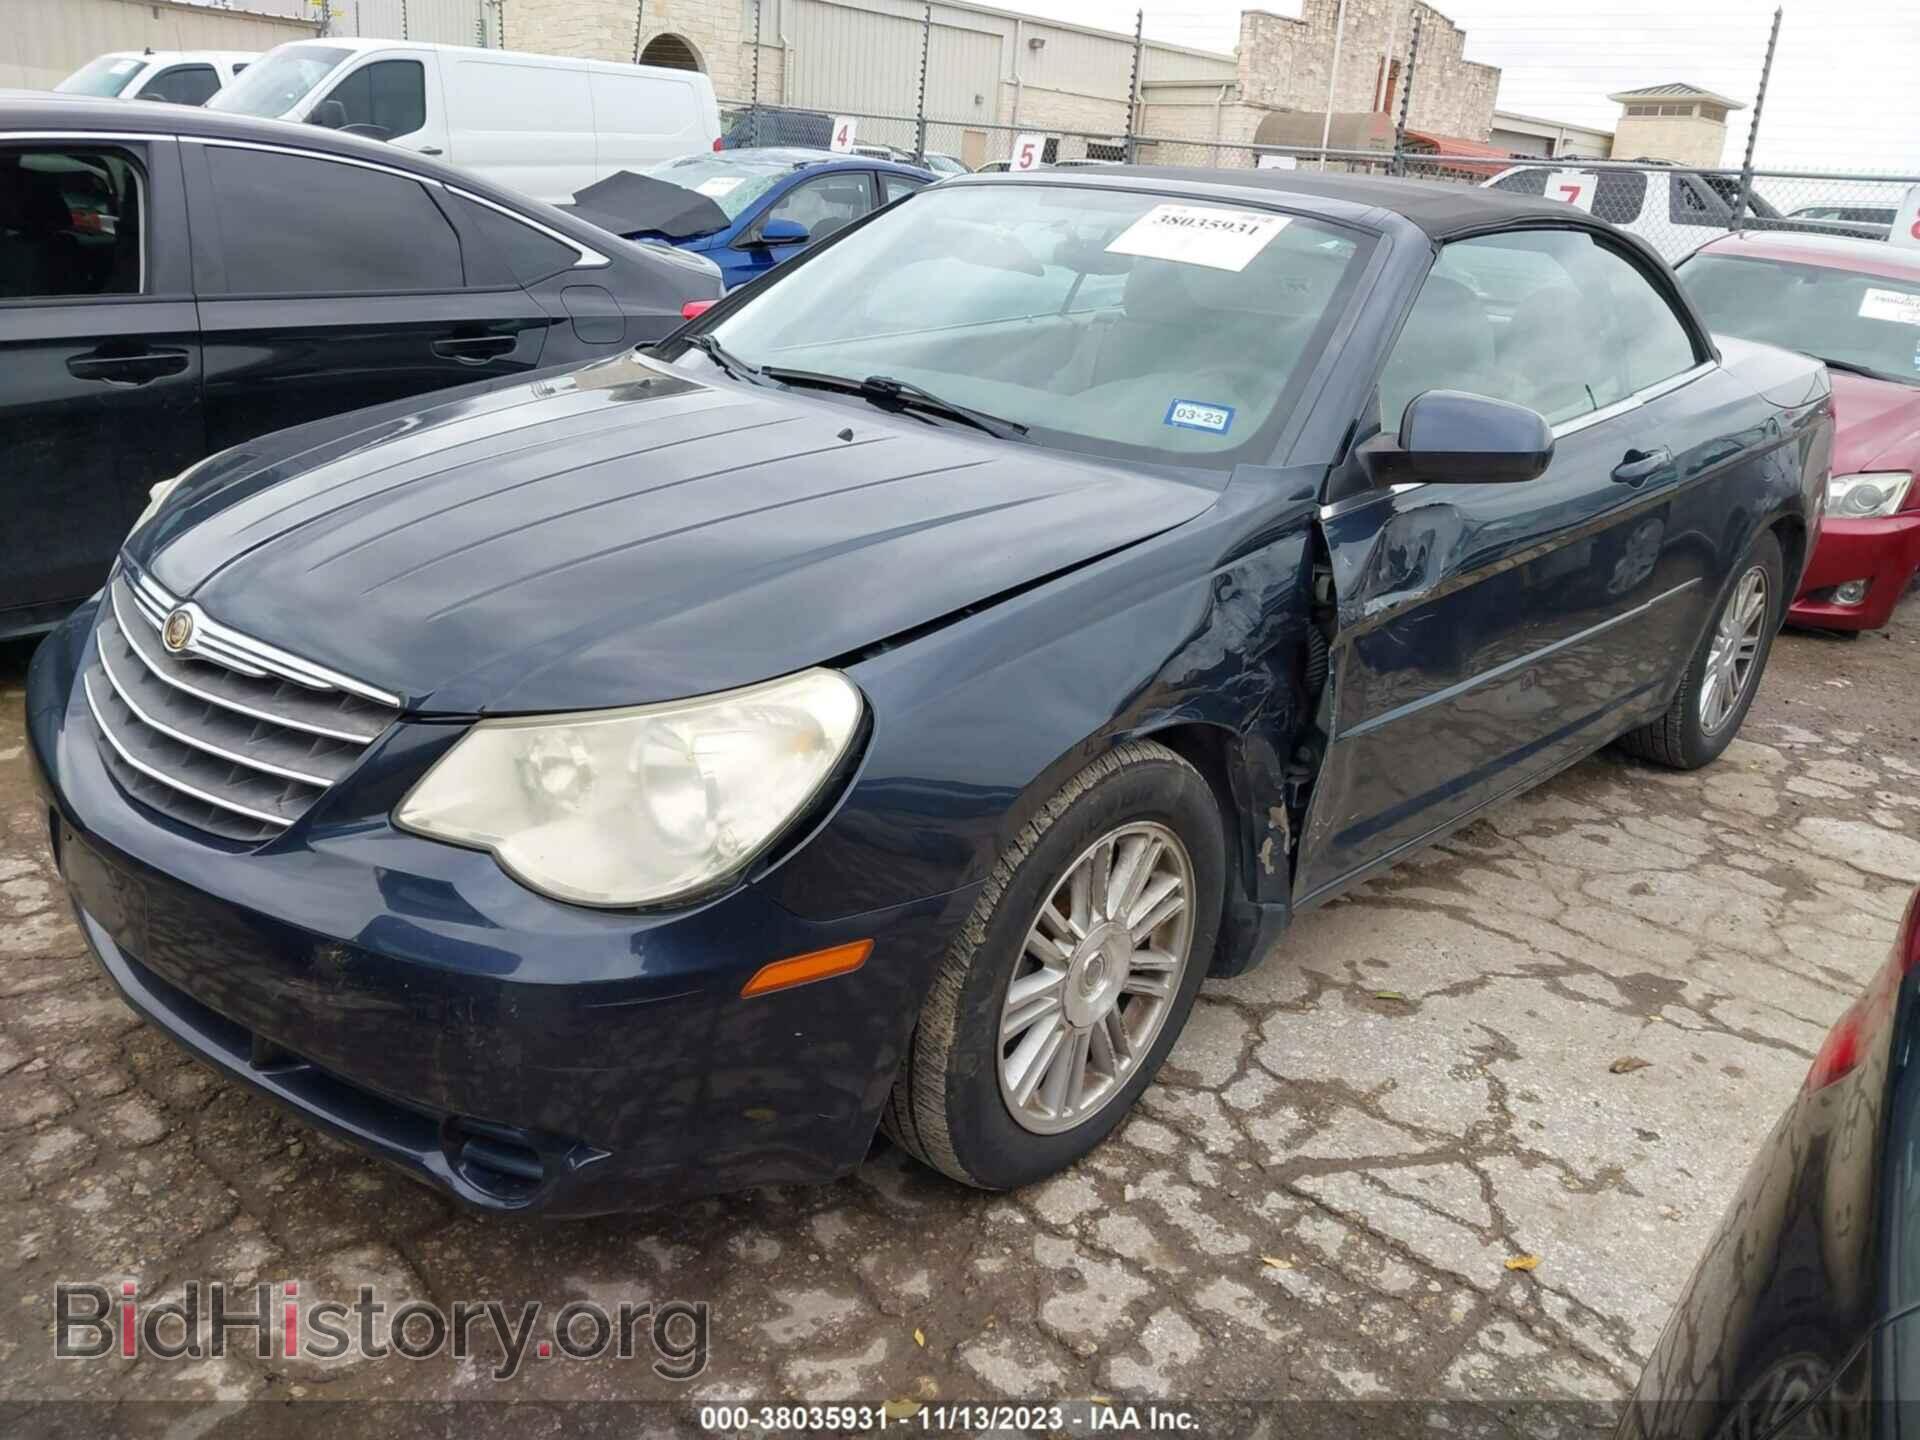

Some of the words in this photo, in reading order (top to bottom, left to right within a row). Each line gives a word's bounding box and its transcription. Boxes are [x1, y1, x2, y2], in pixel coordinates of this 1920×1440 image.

[837, 124, 848, 146] 4
[1020, 144, 1035, 168] 5
[1560, 186, 1581, 204] 7
[1153, 214, 1260, 236] 38035931
